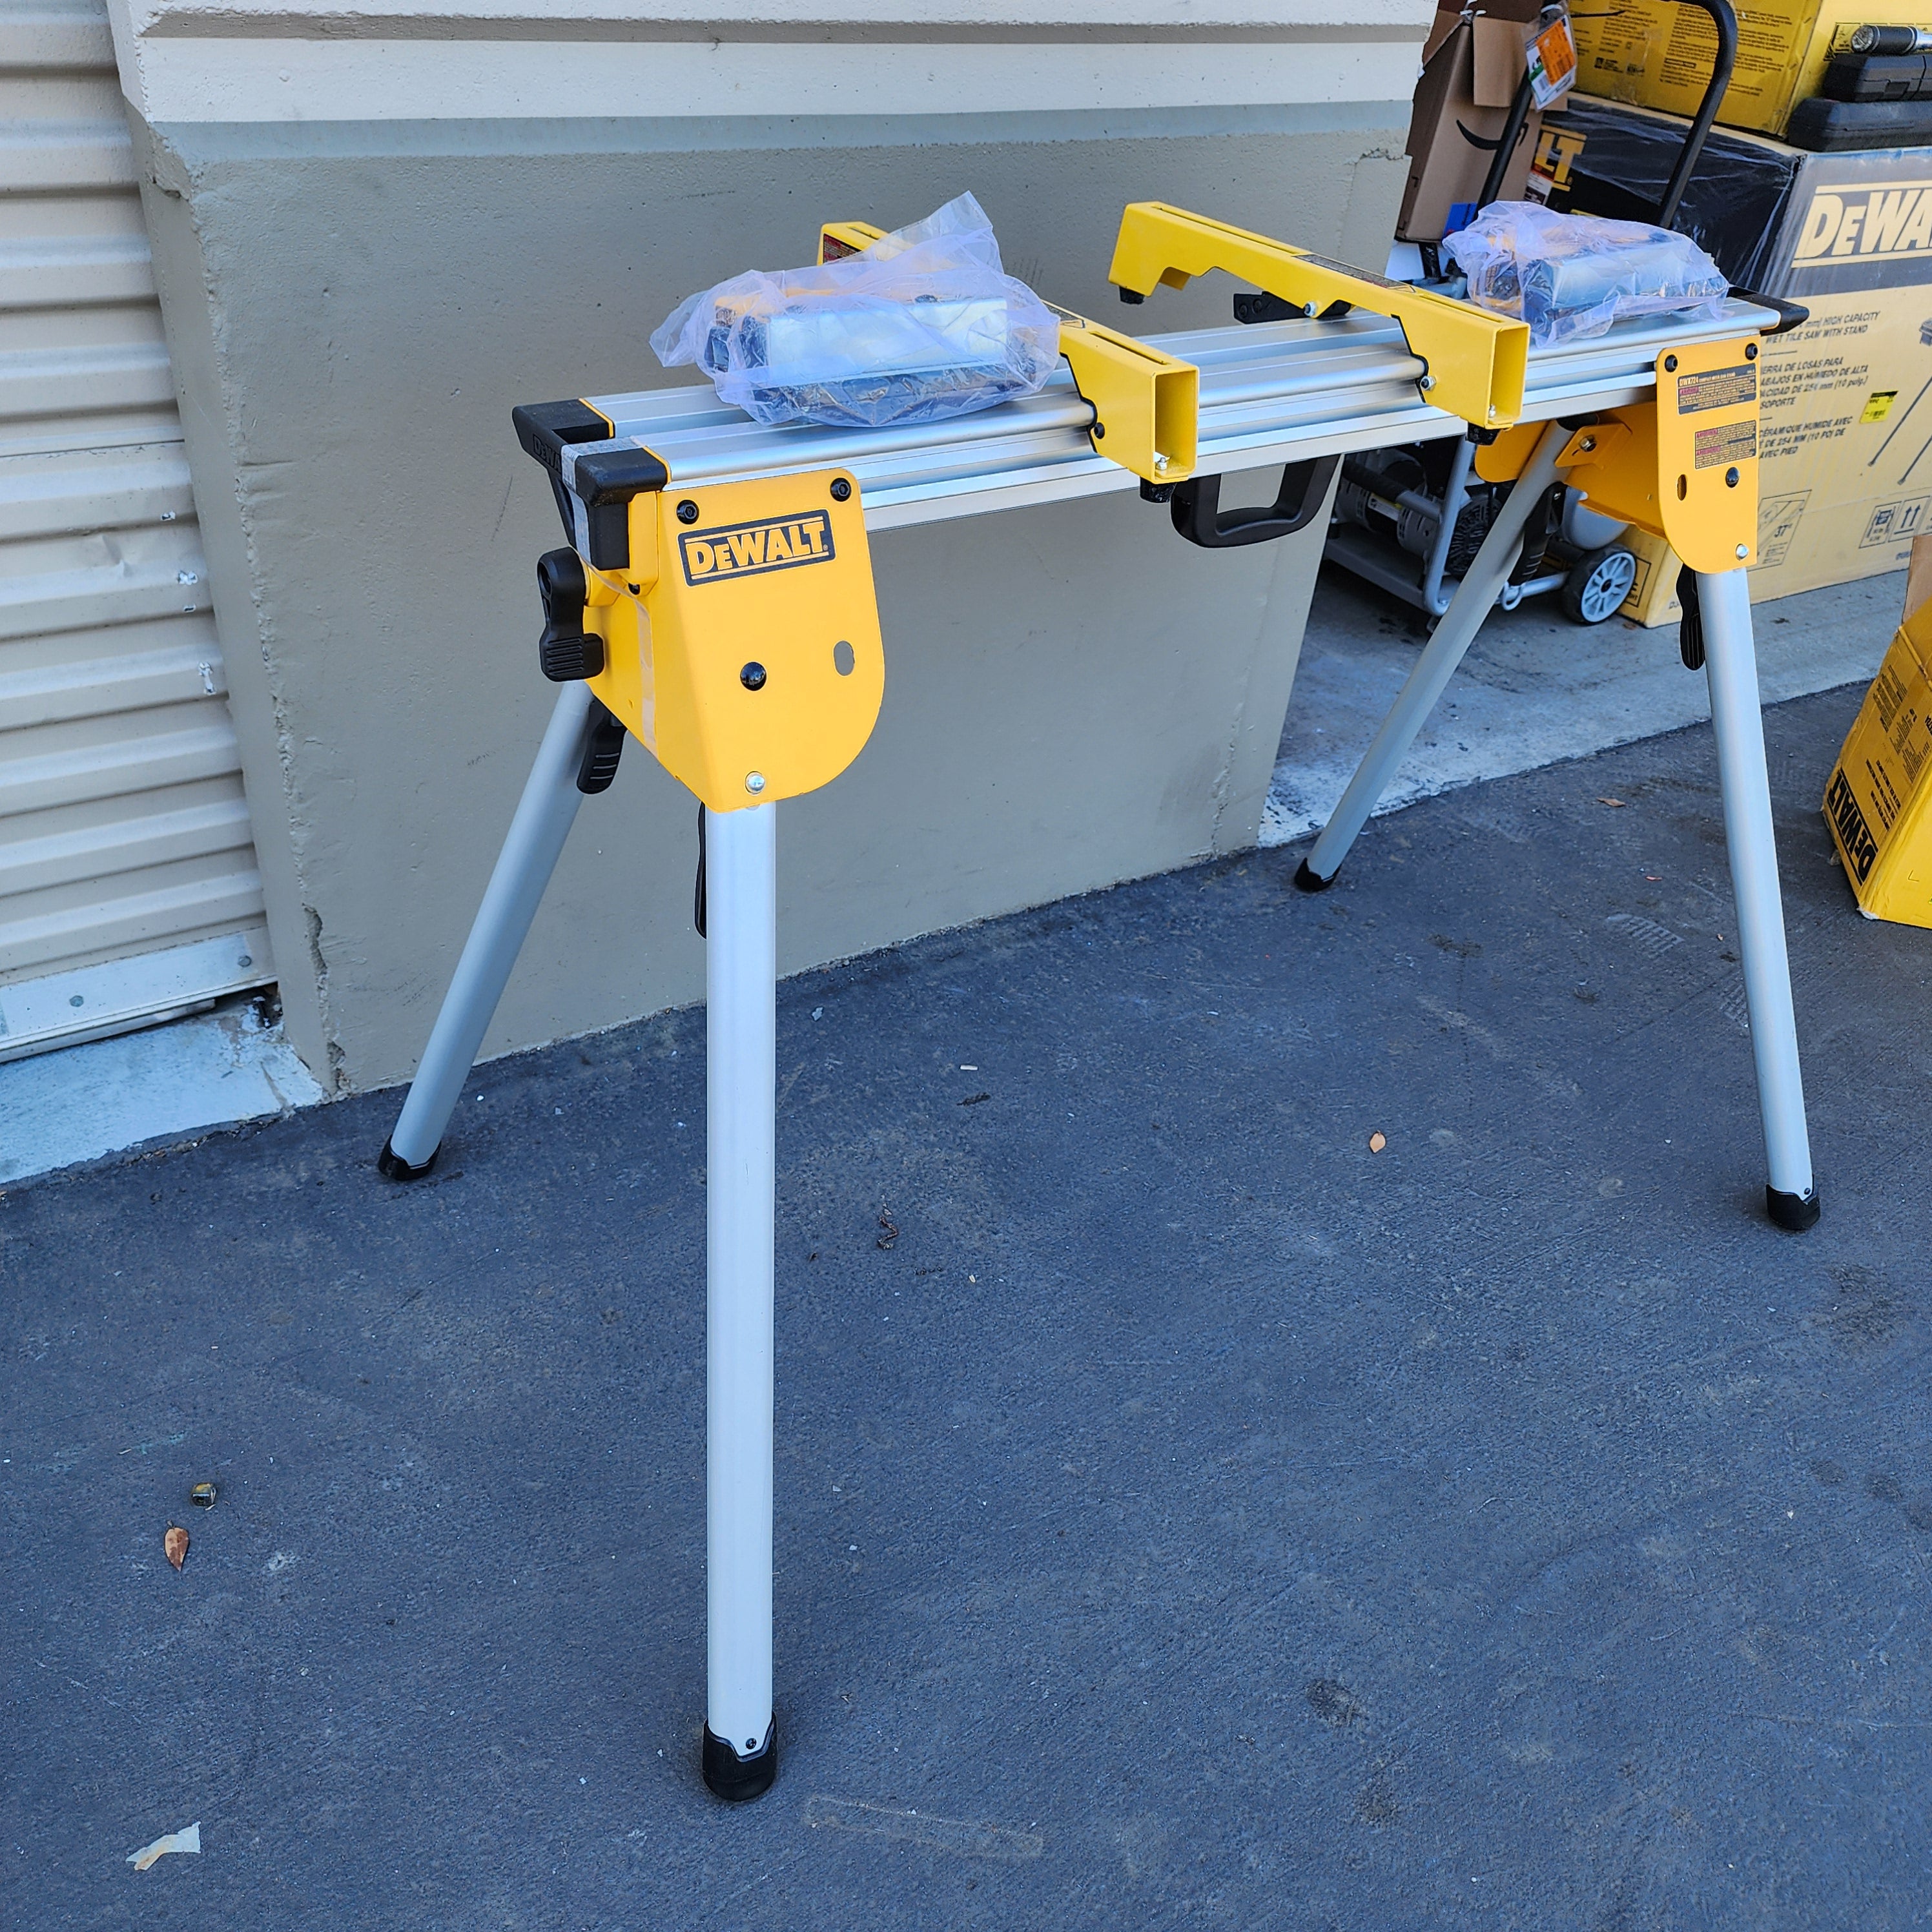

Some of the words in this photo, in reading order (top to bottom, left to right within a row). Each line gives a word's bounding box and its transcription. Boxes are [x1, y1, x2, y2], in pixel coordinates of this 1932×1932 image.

[1794, 187, 1932, 259] DEWA
[1823, 315, 1843, 325] HIGH
[1844, 311, 1881, 324] CAPACITY
[1765, 334, 1783, 344] WET
[1785, 332, 1804, 342] TILE
[1804, 329, 1822, 340] SAW
[1823, 327, 1843, 338] WITH
[1844, 325, 1868, 335] STAND
[1760, 375, 1791, 386] ABAJOS
[1838, 367, 1850, 376] DE
[1851, 364, 1868, 375] ALTA
[1761, 364, 1782, 375] IERRA
[1784, 362, 1796, 372] DE
[1797, 359, 1823, 371] LOSAS
[1824, 356, 1844, 367] PARA
[1760, 396, 1796, 410] SOPORTE
[533, 433, 562, 475] DEWA
[685, 521, 825, 575] DEWALT
[1827, 770, 1876, 883] DEWALT
